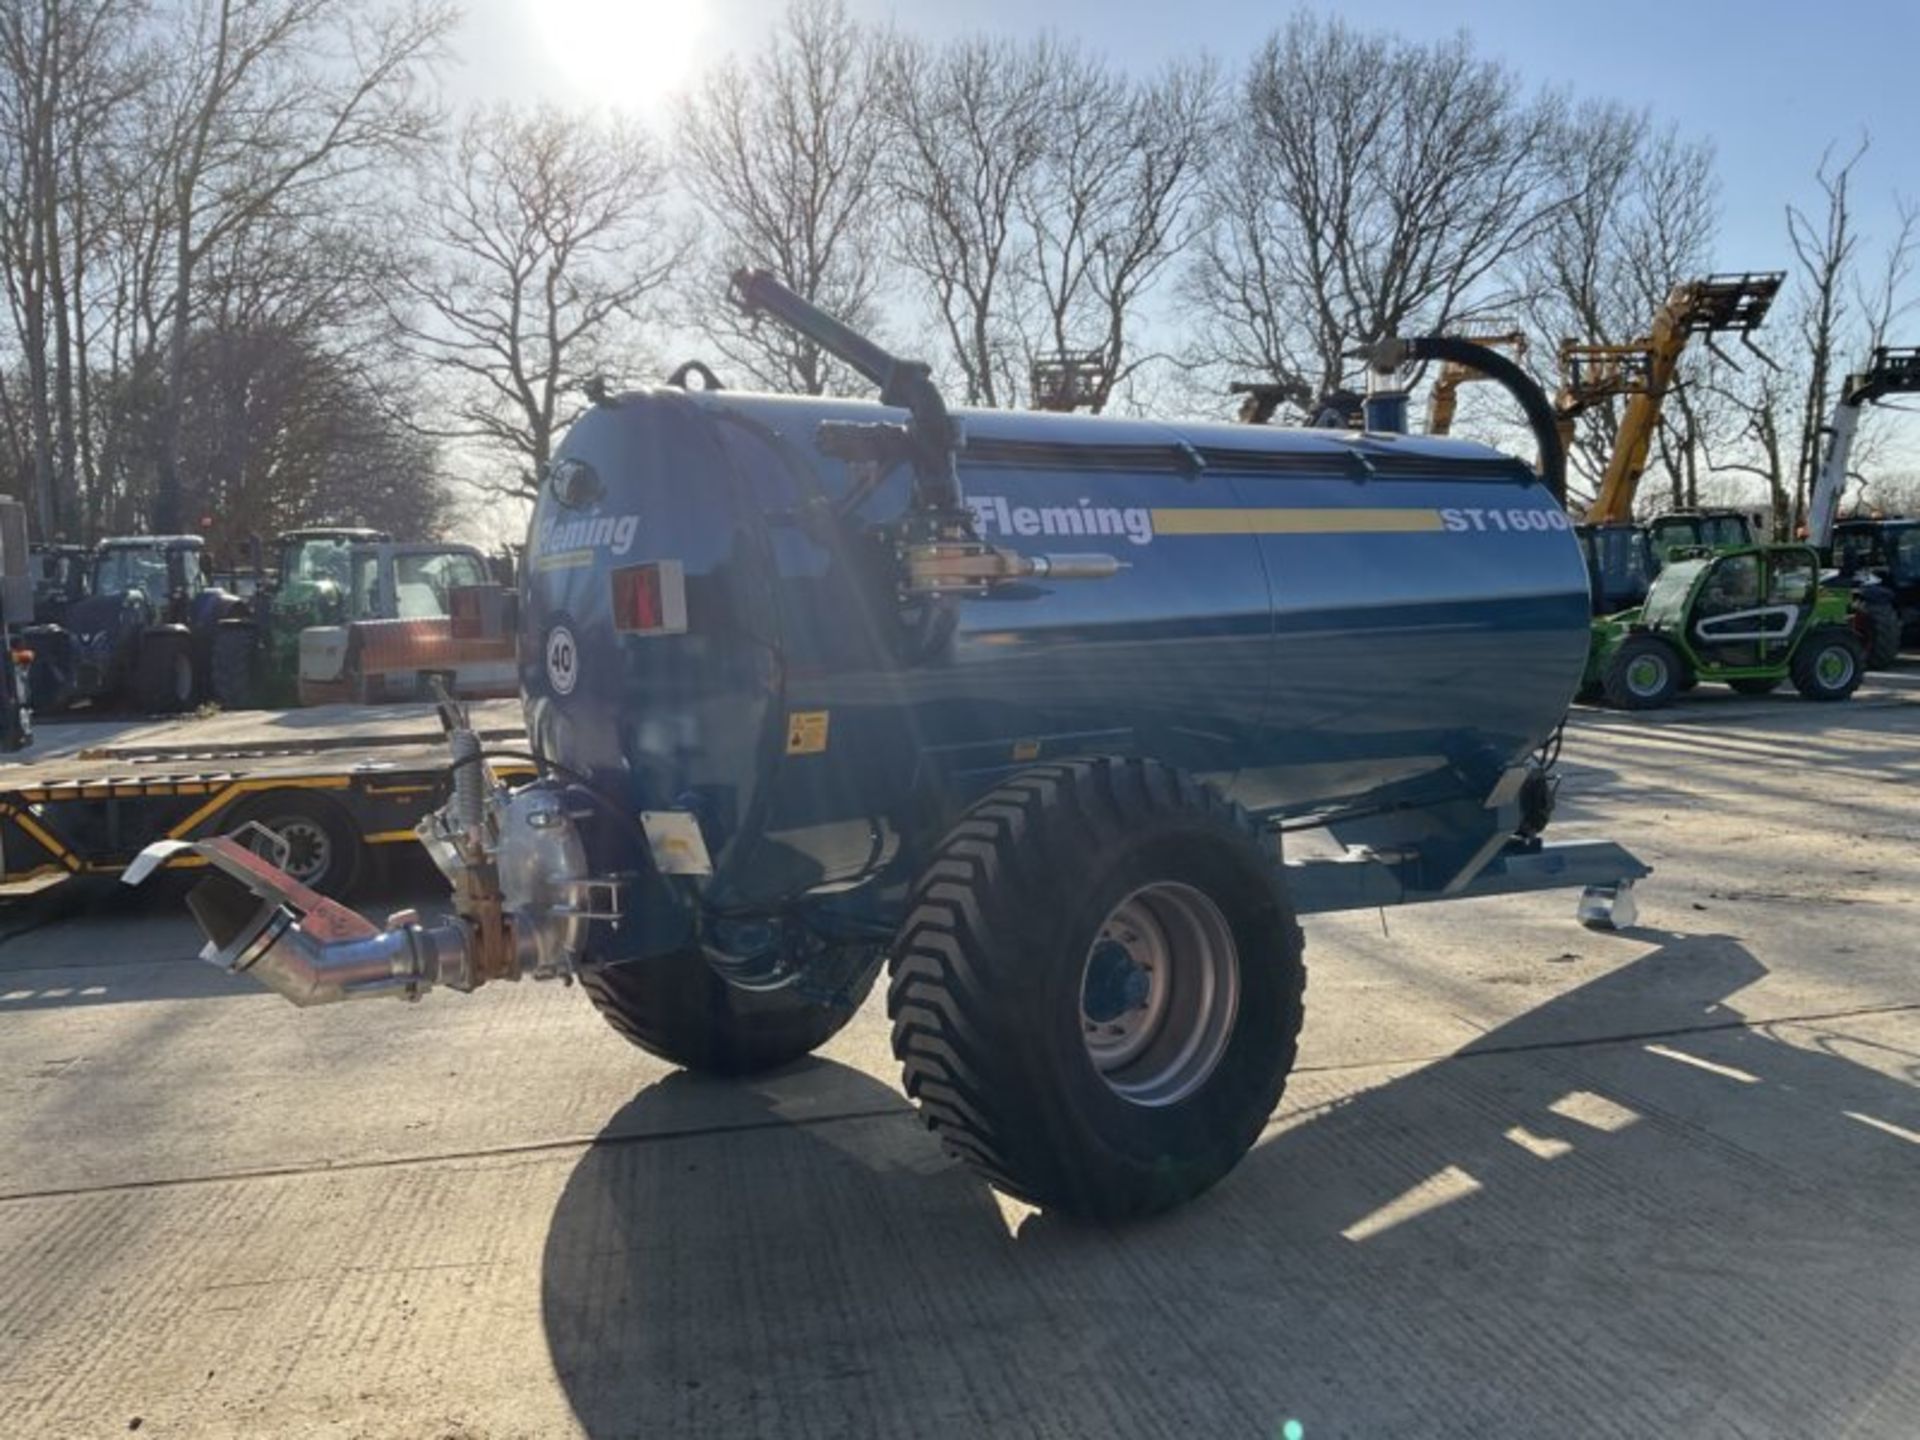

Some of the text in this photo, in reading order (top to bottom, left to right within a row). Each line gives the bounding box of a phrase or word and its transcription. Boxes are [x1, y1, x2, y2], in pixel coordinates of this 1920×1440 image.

[966, 496, 1568, 545] Fleming ST1600
[551, 643, 572, 673] 40
